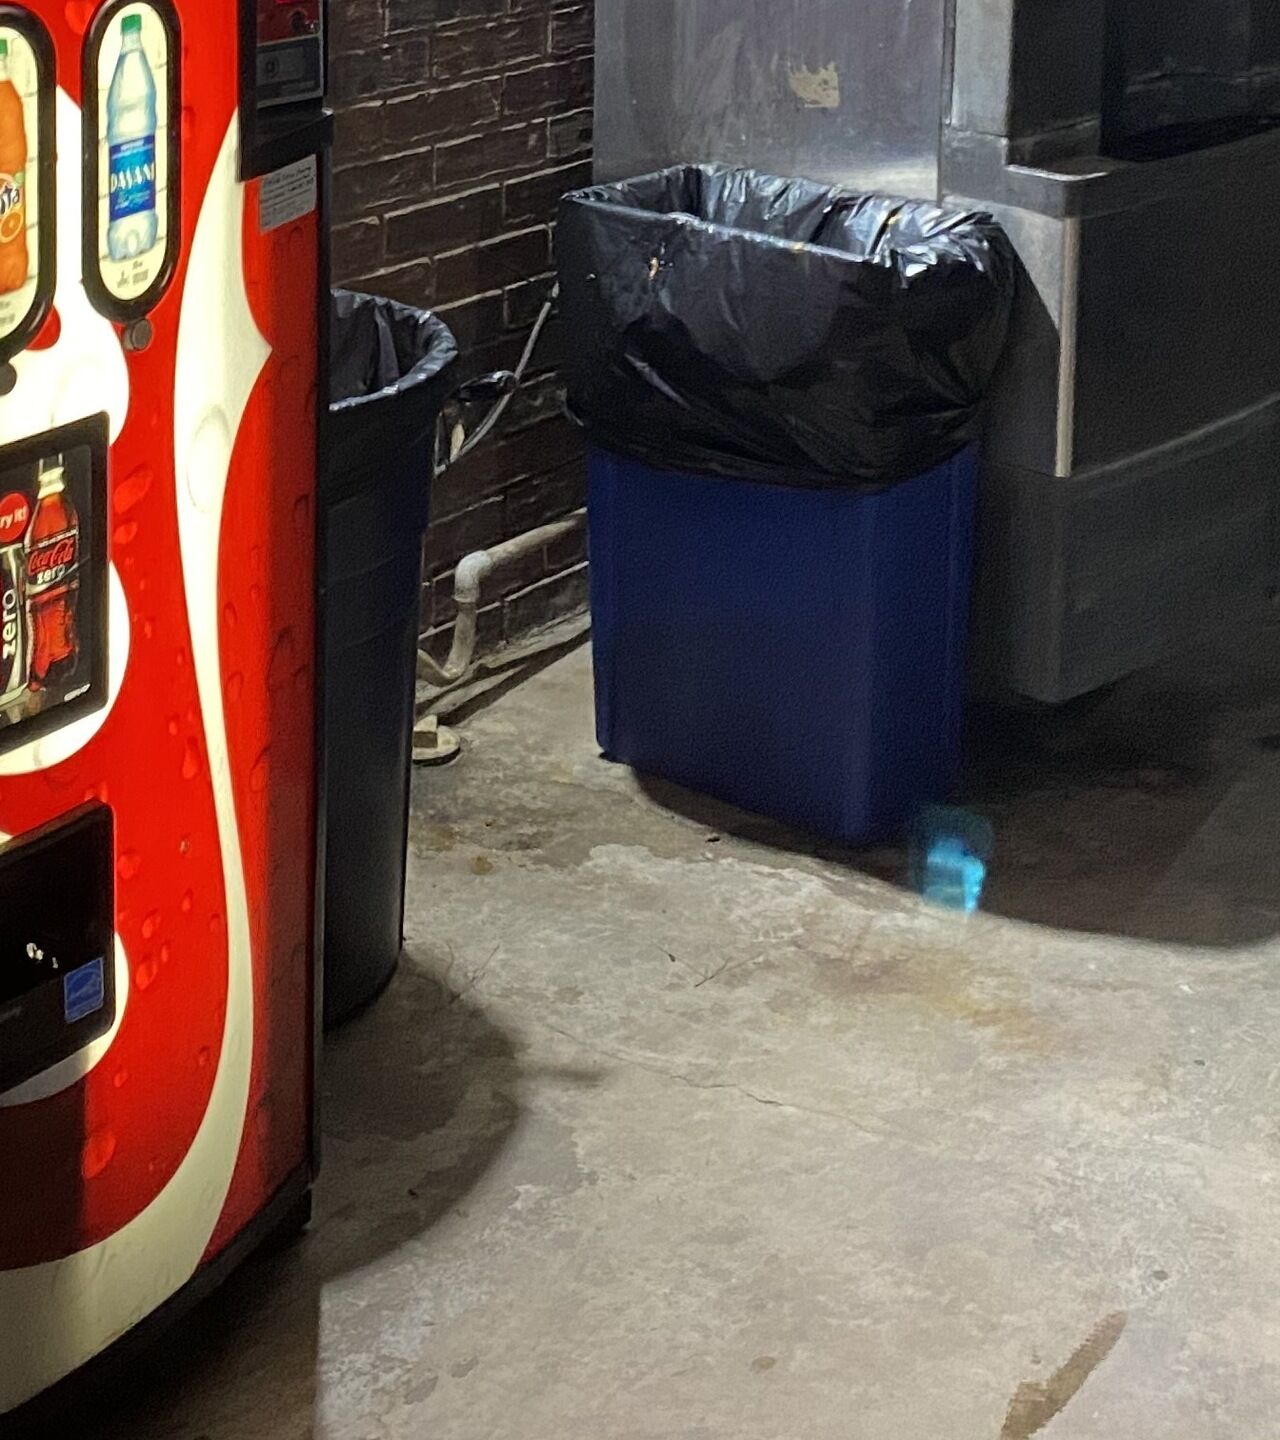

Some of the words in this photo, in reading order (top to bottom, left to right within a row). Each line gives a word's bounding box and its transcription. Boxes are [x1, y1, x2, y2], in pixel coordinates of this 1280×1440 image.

[14, 505, 28, 522] it!
[28, 537, 74, 576] Coca-Cola
[37, 564, 65, 584] zero
[2, 589, 16, 660] zero
